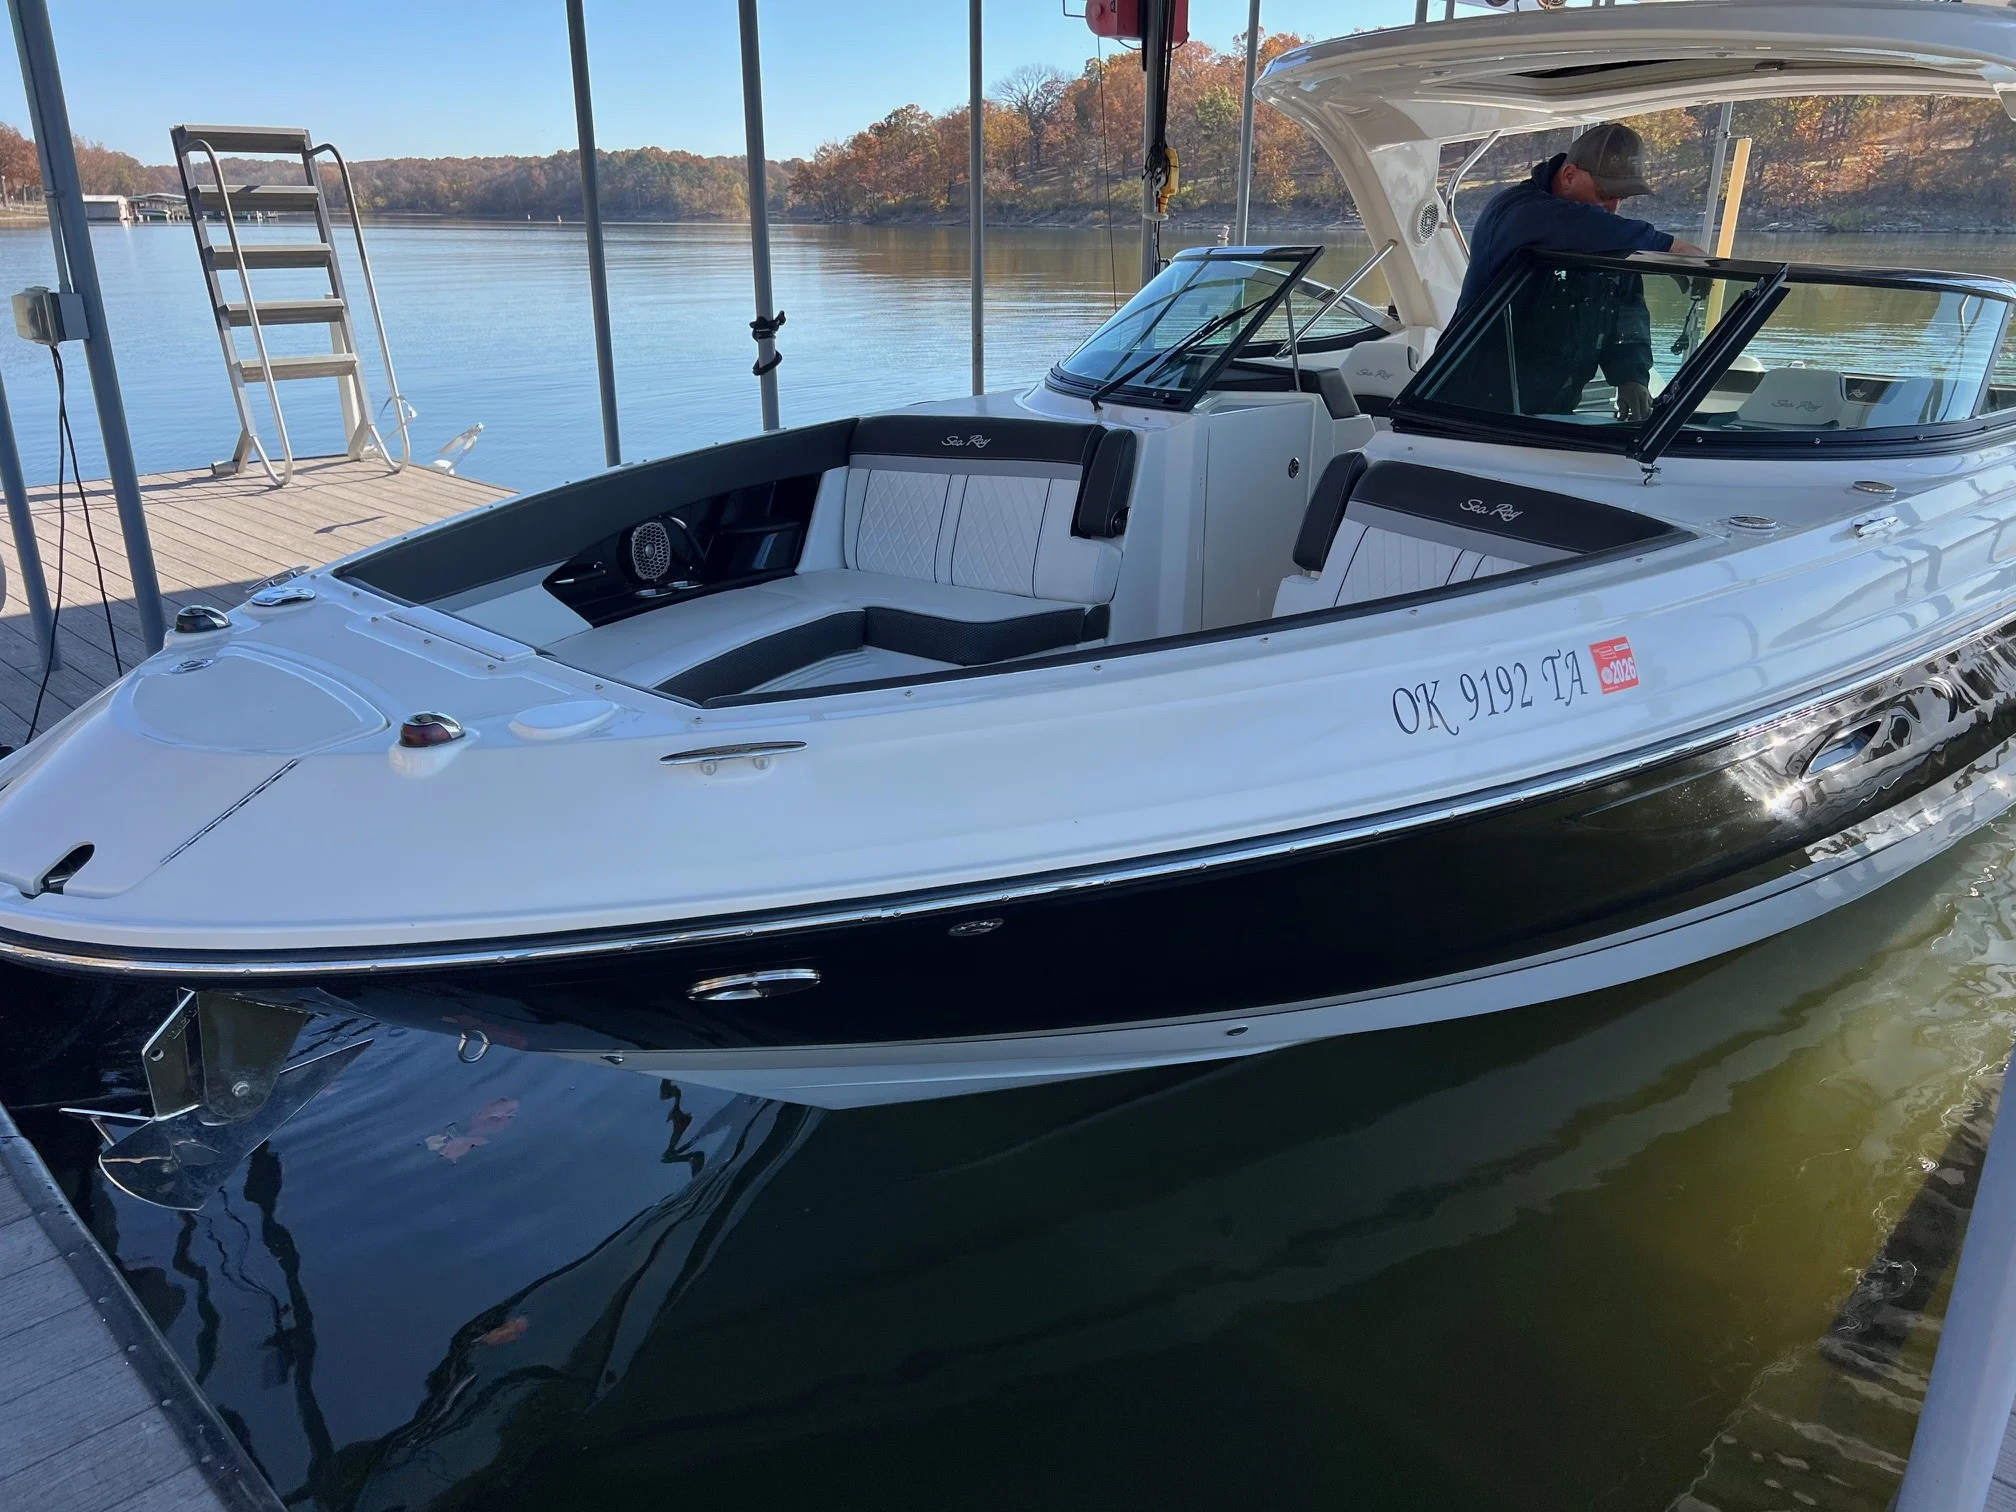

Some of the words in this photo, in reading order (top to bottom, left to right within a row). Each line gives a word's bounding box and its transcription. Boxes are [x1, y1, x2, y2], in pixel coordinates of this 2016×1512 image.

[941, 436, 965, 446] Sea
[966, 434, 991, 448] Ray
[1460, 499, 1489, 514] Sea
[1490, 504, 1523, 521] Ray
[1610, 657, 1636, 684] 2026
[1392, 680, 1459, 736] OK
[1459, 662, 1533, 721] 9192
[1541, 649, 1588, 706] TA
